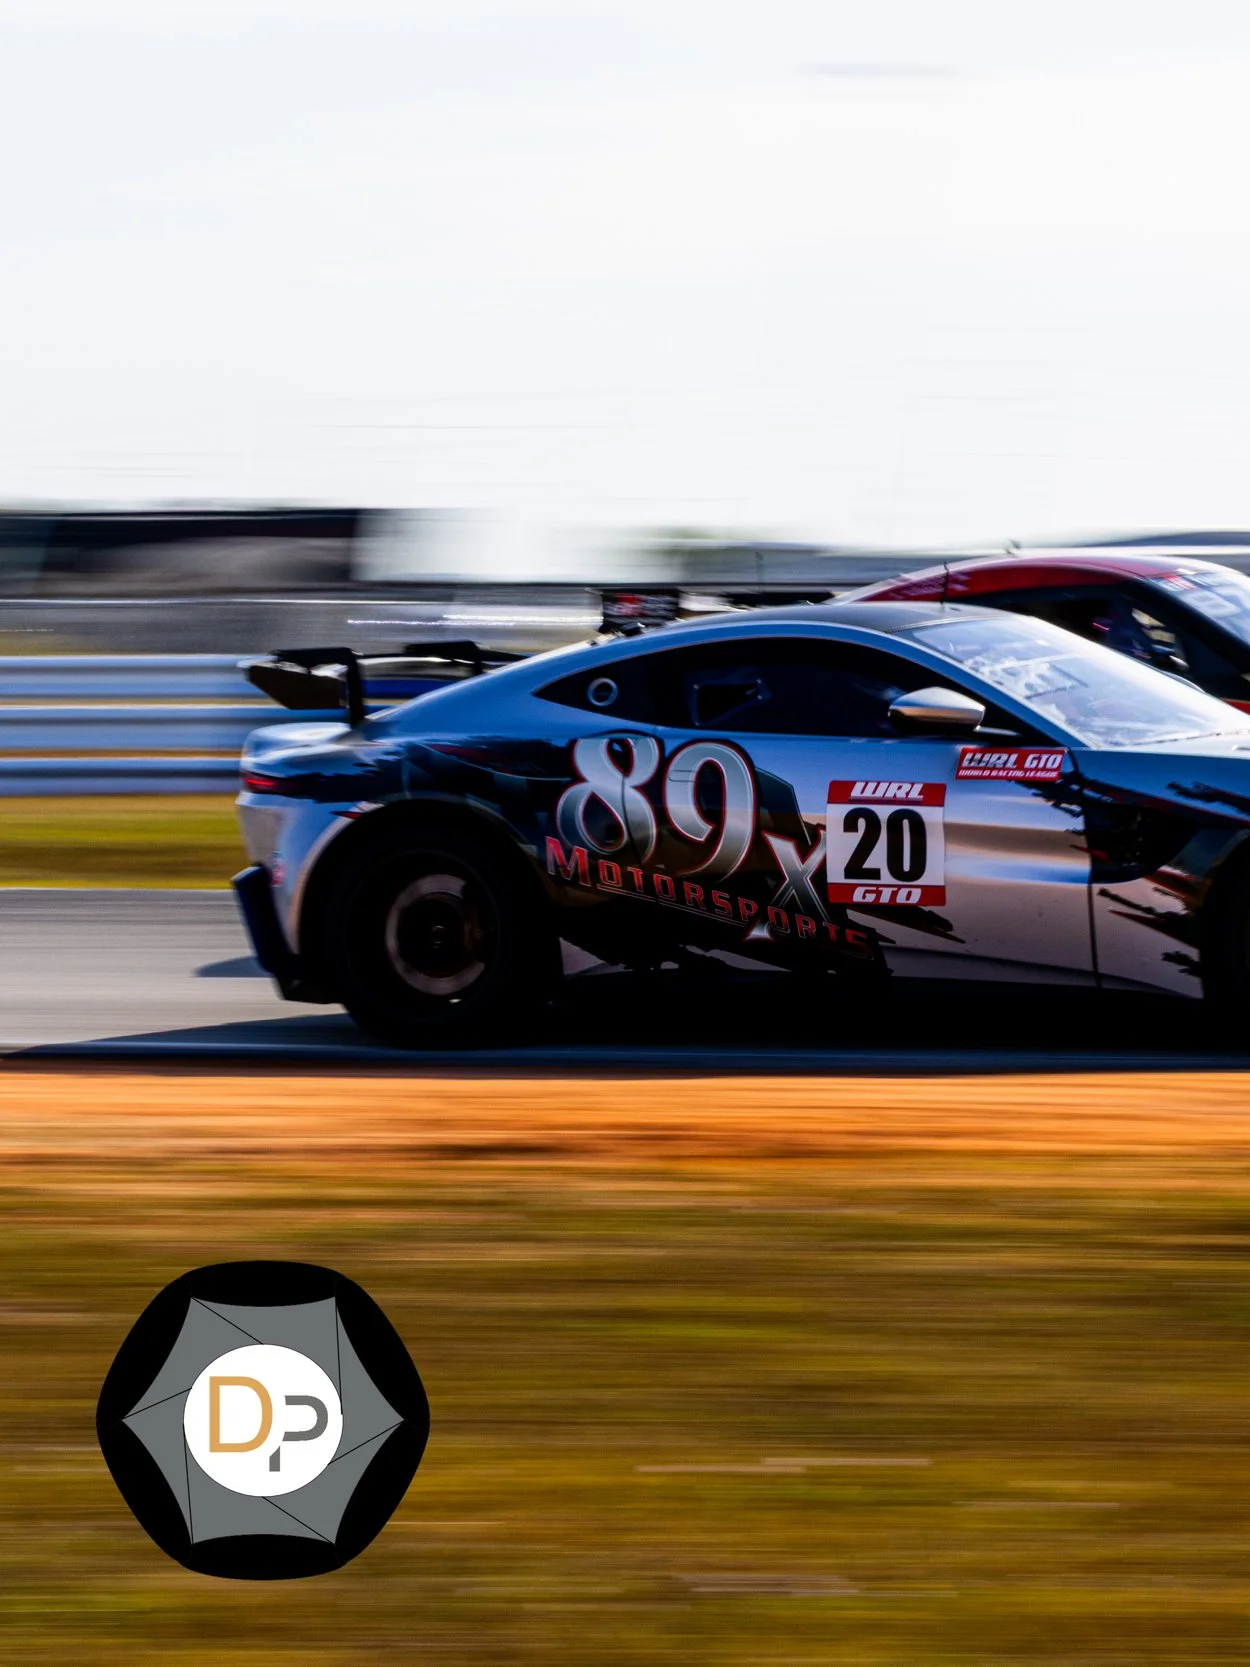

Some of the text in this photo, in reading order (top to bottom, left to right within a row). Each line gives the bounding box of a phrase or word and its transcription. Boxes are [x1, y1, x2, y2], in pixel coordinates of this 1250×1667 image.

[961, 752, 1063, 769] WRL GTO
[850, 781, 925, 799] WRL
[842, 806, 928, 883] 20
[852, 886, 922, 904] GTO
